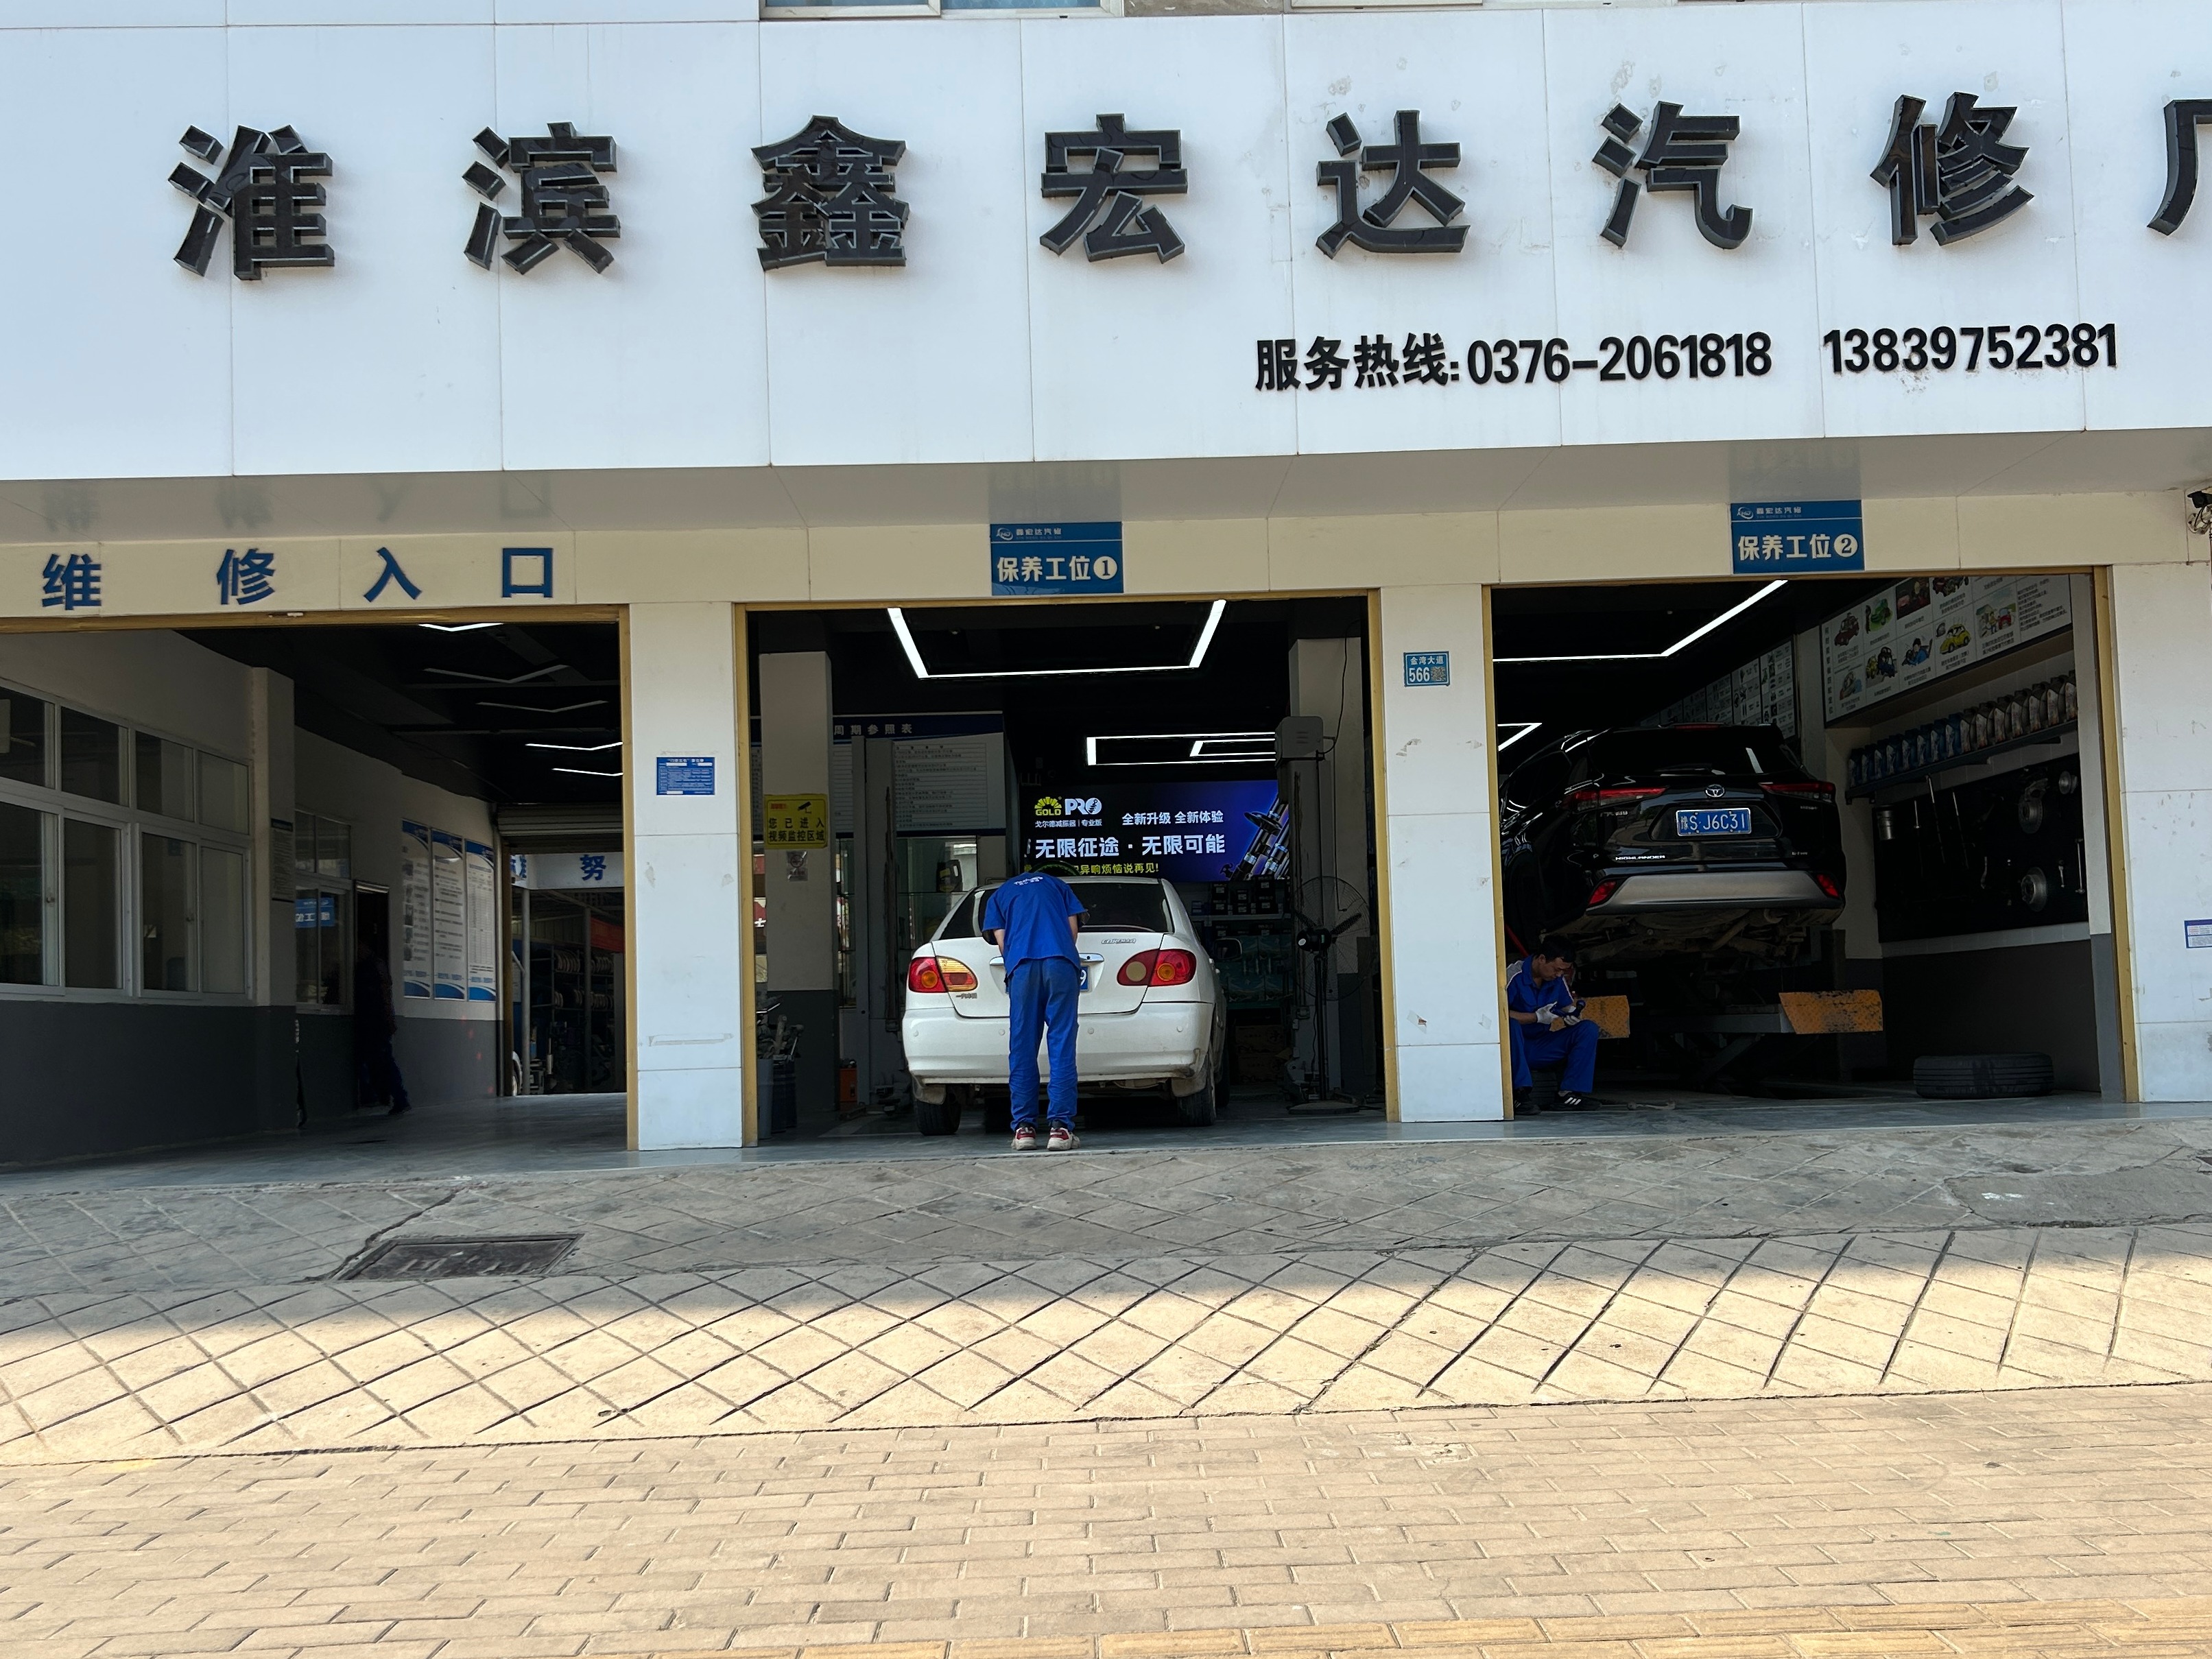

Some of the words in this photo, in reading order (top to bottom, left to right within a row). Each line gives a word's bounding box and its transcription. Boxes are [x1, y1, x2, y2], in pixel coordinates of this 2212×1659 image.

[1823, 323, 2117, 374] 13839752381
[42, 547, 553, 611] 维修入口
[1409, 667, 1430, 682] 566
[1065, 798, 1102, 815] PRO
[769, 817, 824, 828] 您已进入
[1122, 812, 1171, 826] 全新升级
[1175, 811, 1224, 824] 全新体验
[769, 831, 824, 842] 视频监控区域
[580, 854, 606, 881] 努
